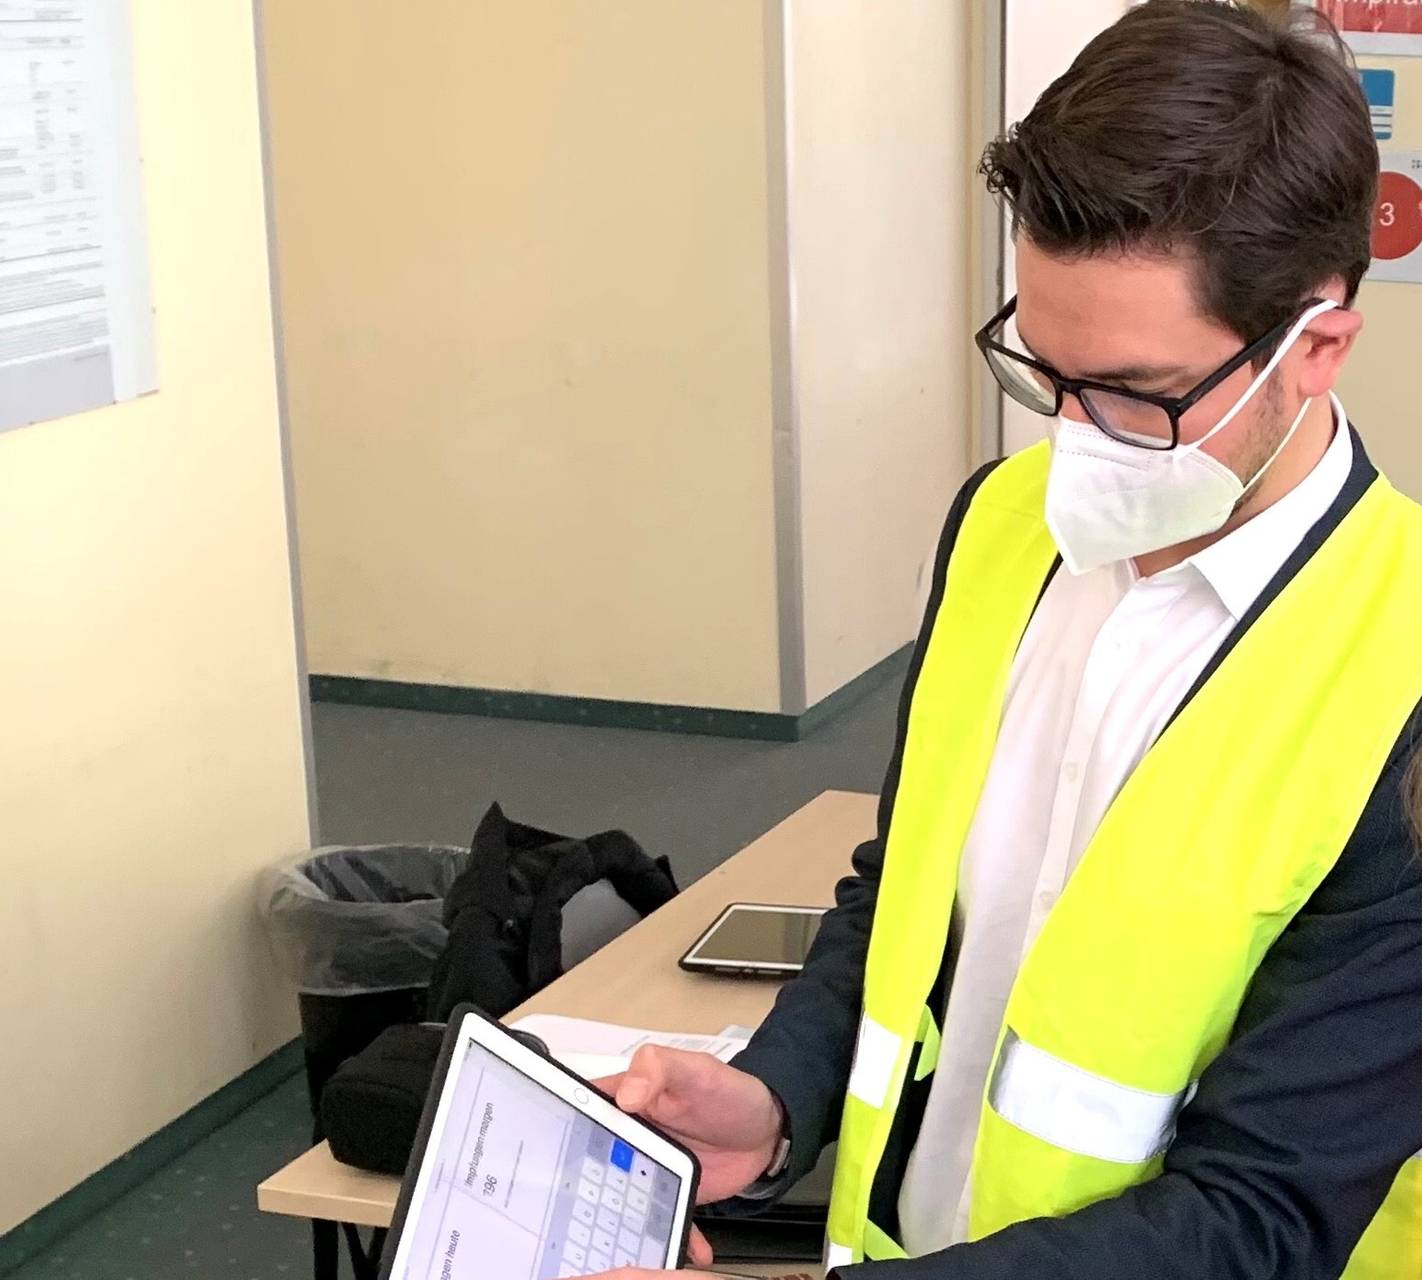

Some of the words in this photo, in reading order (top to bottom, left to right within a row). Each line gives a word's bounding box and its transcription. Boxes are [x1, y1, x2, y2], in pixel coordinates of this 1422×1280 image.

[1379, 202, 1395, 226] 3
[481, 1173, 498, 1198] 196
[446, 1229, 461, 1261] heute
